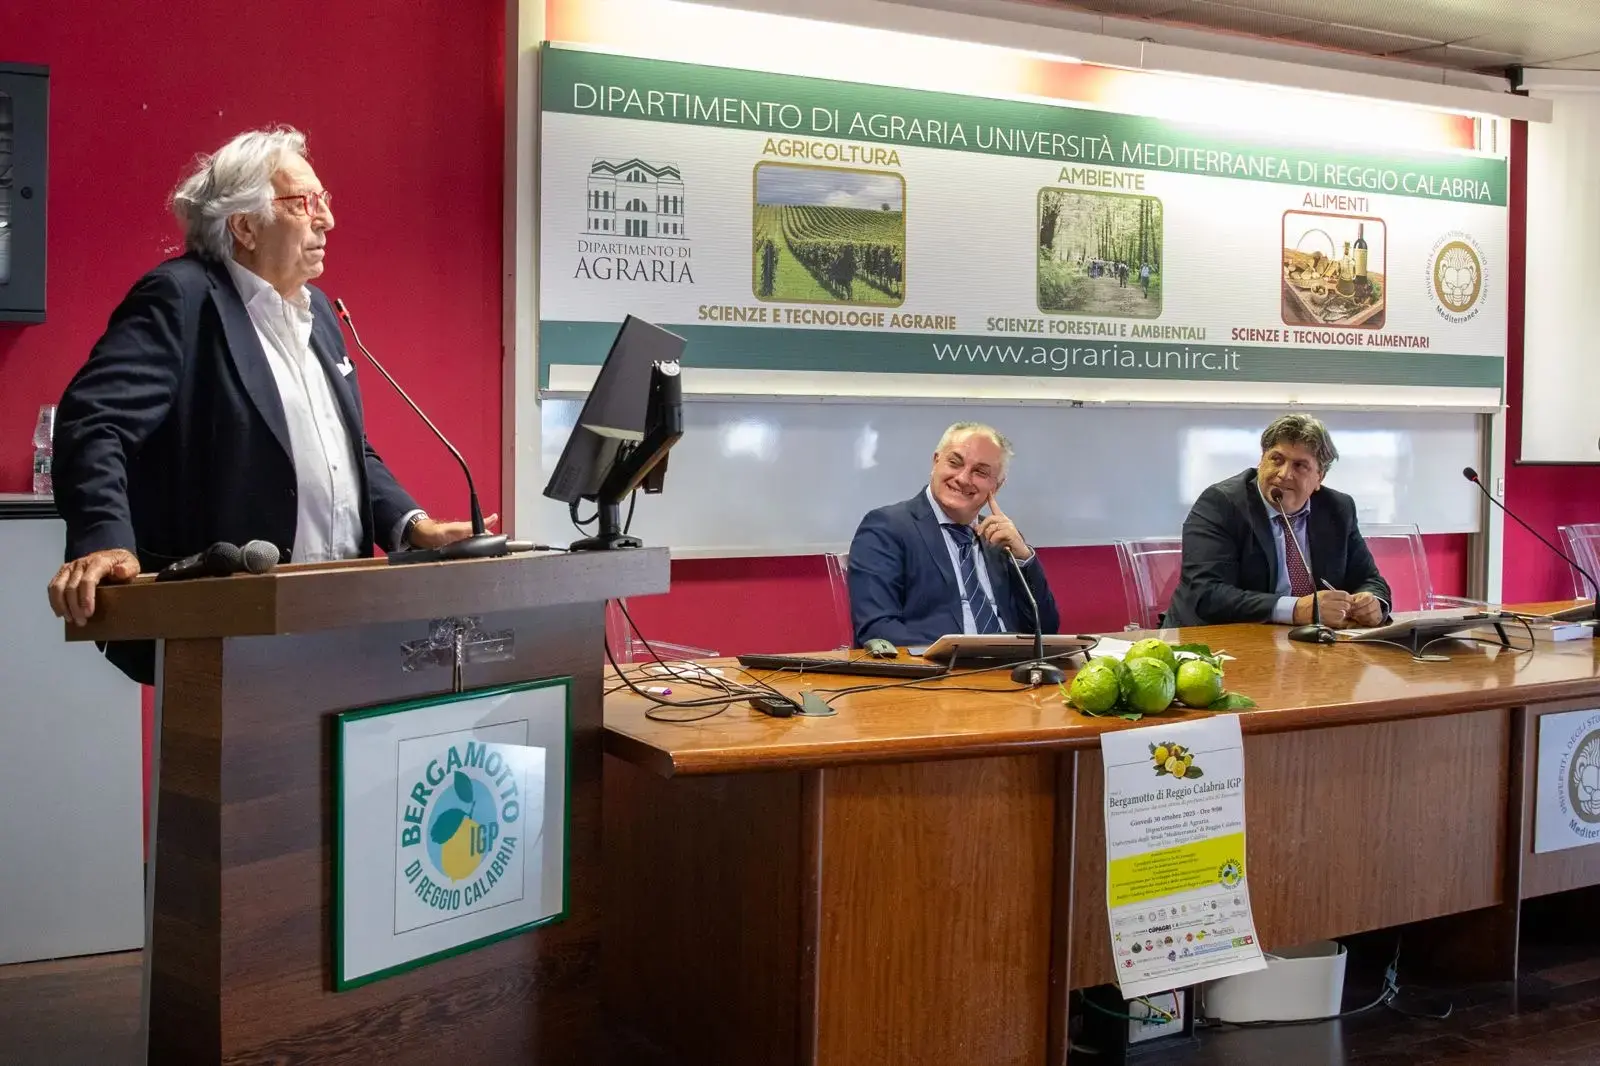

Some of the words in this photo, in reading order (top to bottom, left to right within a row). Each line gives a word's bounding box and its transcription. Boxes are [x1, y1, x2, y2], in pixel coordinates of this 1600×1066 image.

[573, 83, 802, 129] DIPARTIMENTO
[812, 107, 839, 133] DI
[848, 111, 967, 146] AGRARIA
[976, 125, 1114, 161] UNIVERSITÀ
[1122, 142, 1291, 180] MEDITERRANEA
[1298, 161, 1319, 183] DI
[1323, 164, 1398, 192] REGGIO
[1402, 172, 1492, 202] CALABRIA
[763, 138, 901, 167] AGRICOLTURA
[1058, 166, 1145, 191] AMBIENTE
[1302, 192, 1369, 213] ALIMENTI
[577, 240, 674, 258] DIPARTIMENTO
[678, 245, 692, 258] DI
[573, 257, 695, 284] AGRARIA
[698, 305, 767, 323] SCIENZE
[773, 308, 781, 323] E
[784, 309, 885, 328] TECNOLOGIE
[890, 313, 956, 331] AGRARIE
[1436, 304, 1479, 324] Mediterranea
[987, 317, 1044, 333] SCIENZE
[1049, 320, 1117, 337] FORESTALI
[1120, 323, 1126, 337] E
[1131, 323, 1206, 340] AMBIENTALI
[1232, 327, 1279, 342] SCIENZE
[1284, 330, 1289, 342] E
[1293, 330, 1364, 346] TECNOLOGIE
[1367, 333, 1430, 348] ALIMENTARI
[933, 344, 1241, 371] www.agraria.unirc.it
[1567, 720, 1587, 750] DEGLI
[402, 741, 520, 848] BERGAMOTTO
[1109, 793, 1155, 808] Bergamotto
[1156, 789, 1164, 800] di
[1166, 786, 1191, 800] Reggio
[1193, 781, 1225, 794] Calabria
[1227, 777, 1241, 789] IGP
[470, 821, 499, 857] IGP
[404, 859, 420, 883] DI
[414, 877, 460, 911] REGGIO
[464, 836, 517, 906] CALABRIA
